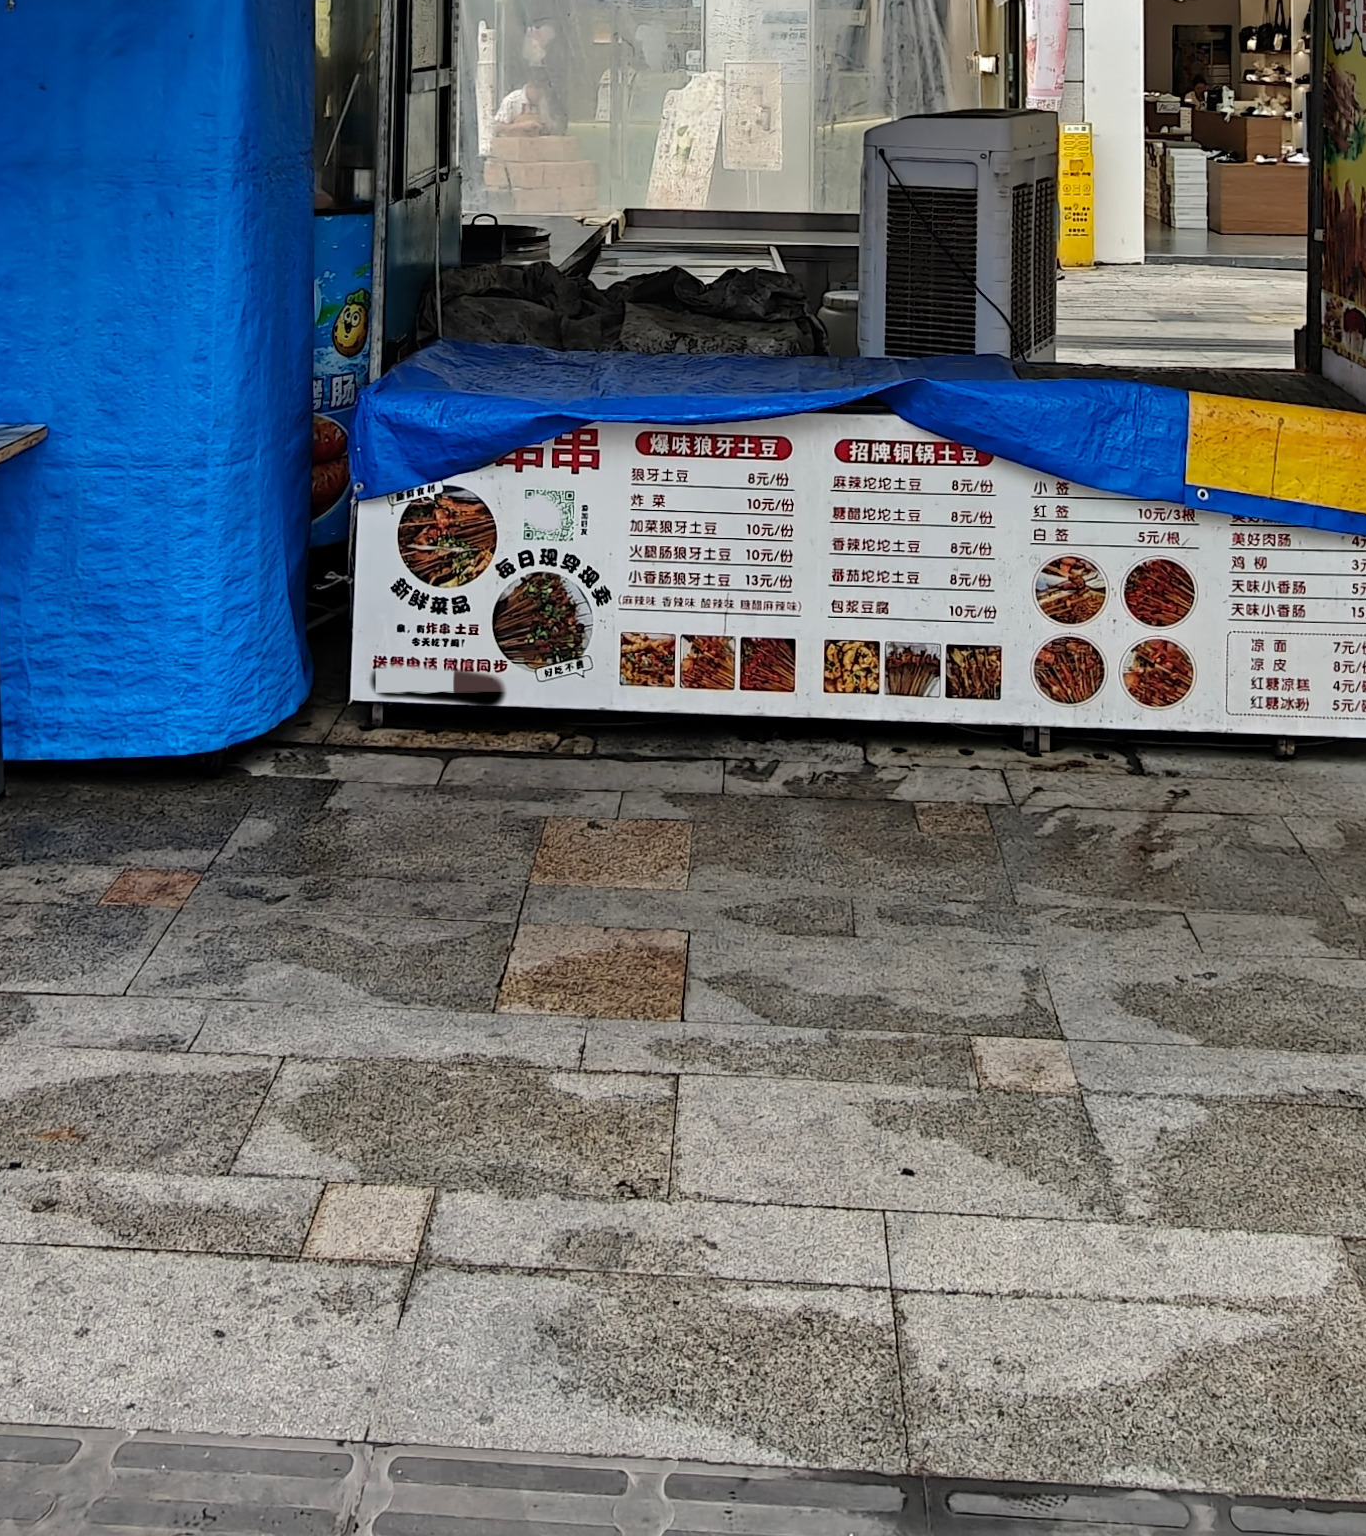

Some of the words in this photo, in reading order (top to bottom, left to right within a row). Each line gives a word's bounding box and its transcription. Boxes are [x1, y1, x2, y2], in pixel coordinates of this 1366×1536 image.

[649, 434, 779, 458] 爆味狼牙土豆
[849, 441, 979, 464] 招牌铜锅土豆
[631, 468, 689, 483] 狼牙土豆
[747, 472, 789, 487] 8元/份
[832, 475, 922, 491] 麻辣坨坨土豆
[951, 479, 994, 493] 8元/份
[746, 498, 794, 512] 10元/份
[832, 506, 921, 522] 糖醋坨坨土豆
[950, 511, 993, 525] 8元/份
[1137, 508, 1196, 522] 10元/3根
[630, 519, 717, 535] 加菜狼牙土豆
[746, 523, 794, 538] 10元/份
[831, 537, 921, 553] 香辣坨坨土豆
[950, 542, 992, 556] 8元/份
[1137, 531, 1180, 545] 5元/根
[1231, 532, 1292, 547] 美好肉肠
[629, 545, 732, 561] 火腿肠狼牙土豆
[745, 549, 793, 563] 10元/份
[495, 548, 612, 607] 每日现穿现卖
[628, 570, 731, 587] 小香肠狼牙土豆
[745, 574, 793, 589] 13元/份
[831, 568, 920, 585] 番茄坨坨土豆
[949, 573, 992, 588] 8元/份
[390, 577, 471, 615] 新鲜菜品
[1231, 579, 1306, 595] 天味小香肠
[662, 596, 696, 608] 香辣味
[831, 600, 889, 615] 包浆豆腐
[949, 605, 997, 620] 10元/份
[1231, 603, 1306, 618] 天味小香肠
[443, 658, 508, 673] 微信同步
[1250, 677, 1311, 692] 红糖凉糕
[1250, 696, 1310, 711] 红糖冰粉
